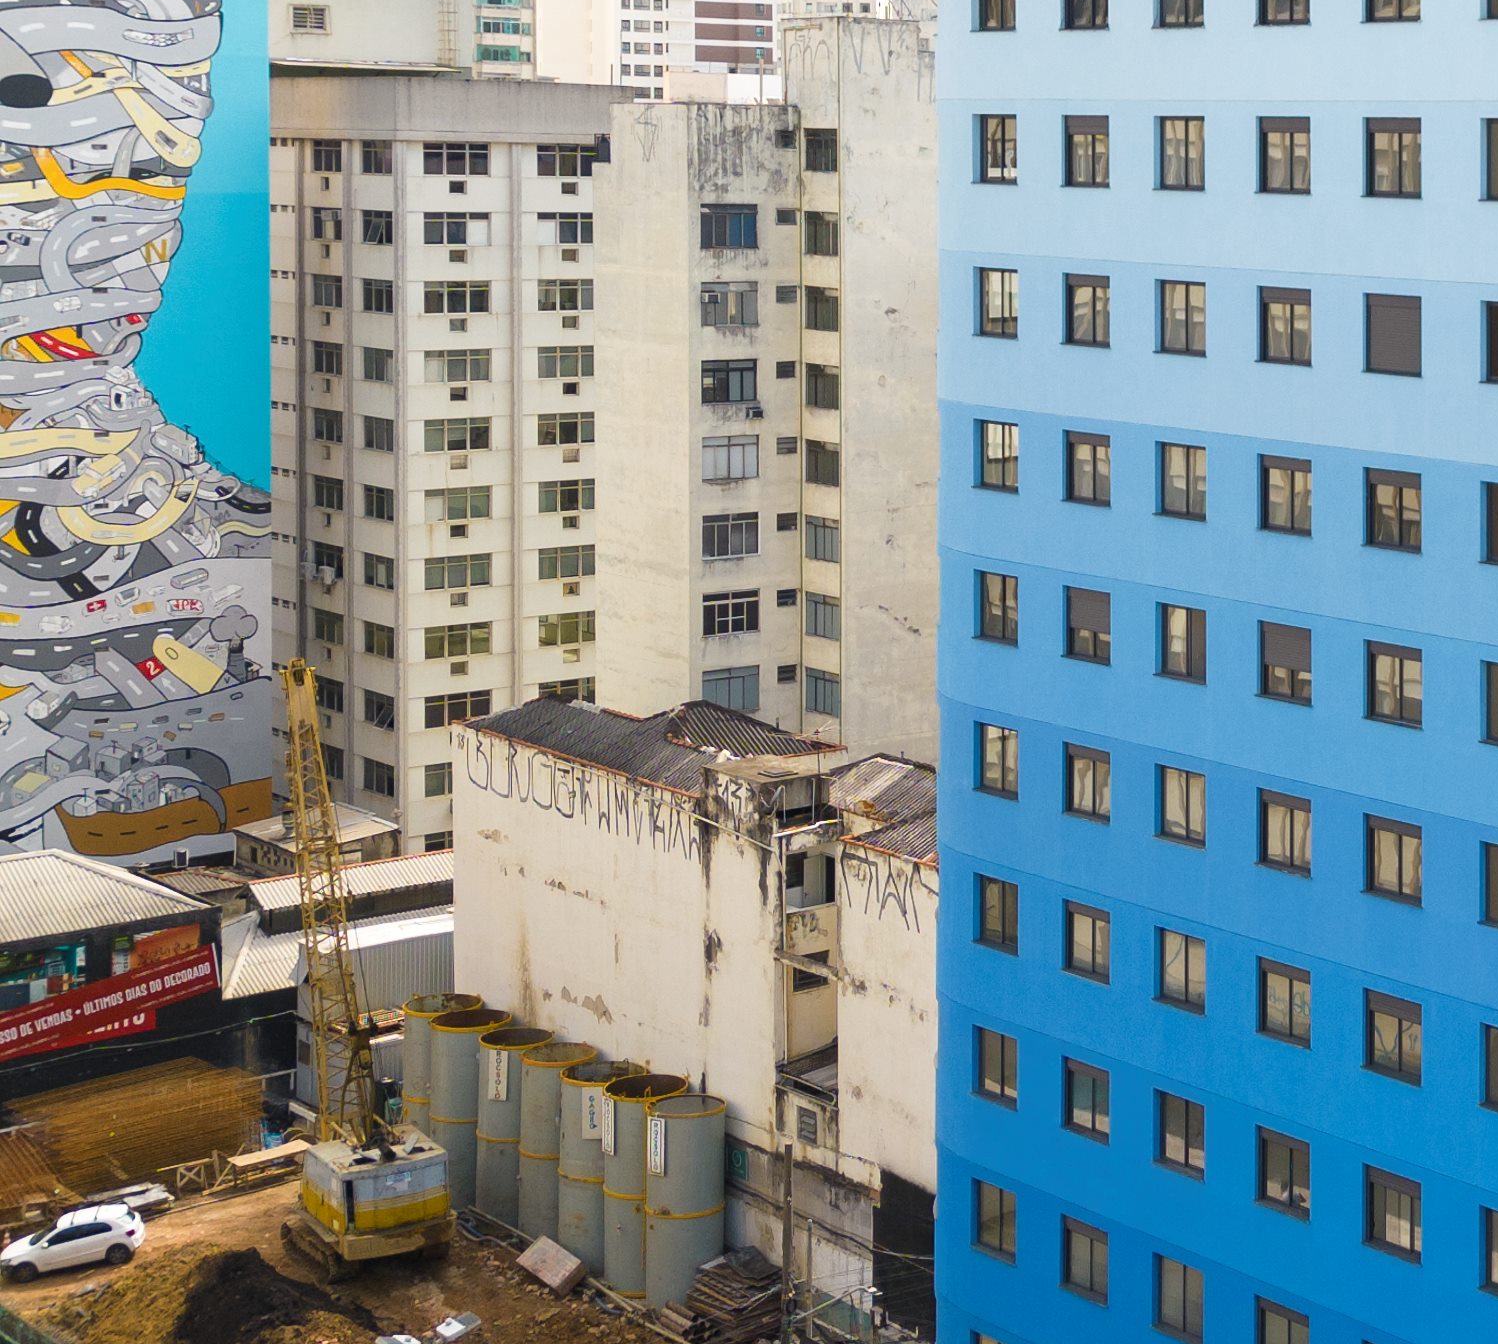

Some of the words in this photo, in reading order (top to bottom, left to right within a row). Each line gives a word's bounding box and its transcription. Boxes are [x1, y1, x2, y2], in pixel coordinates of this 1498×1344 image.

[146, 661, 159, 674] 2
[20, 1021, 33, 1037] DE
[34, 1008, 74, 1032] VENDAS
[82, 991, 124, 1016] ÚLTIMOS
[125, 983, 148, 1001] DIAS
[149, 978, 163, 994] DO
[164, 961, 212, 989] DECORADO
